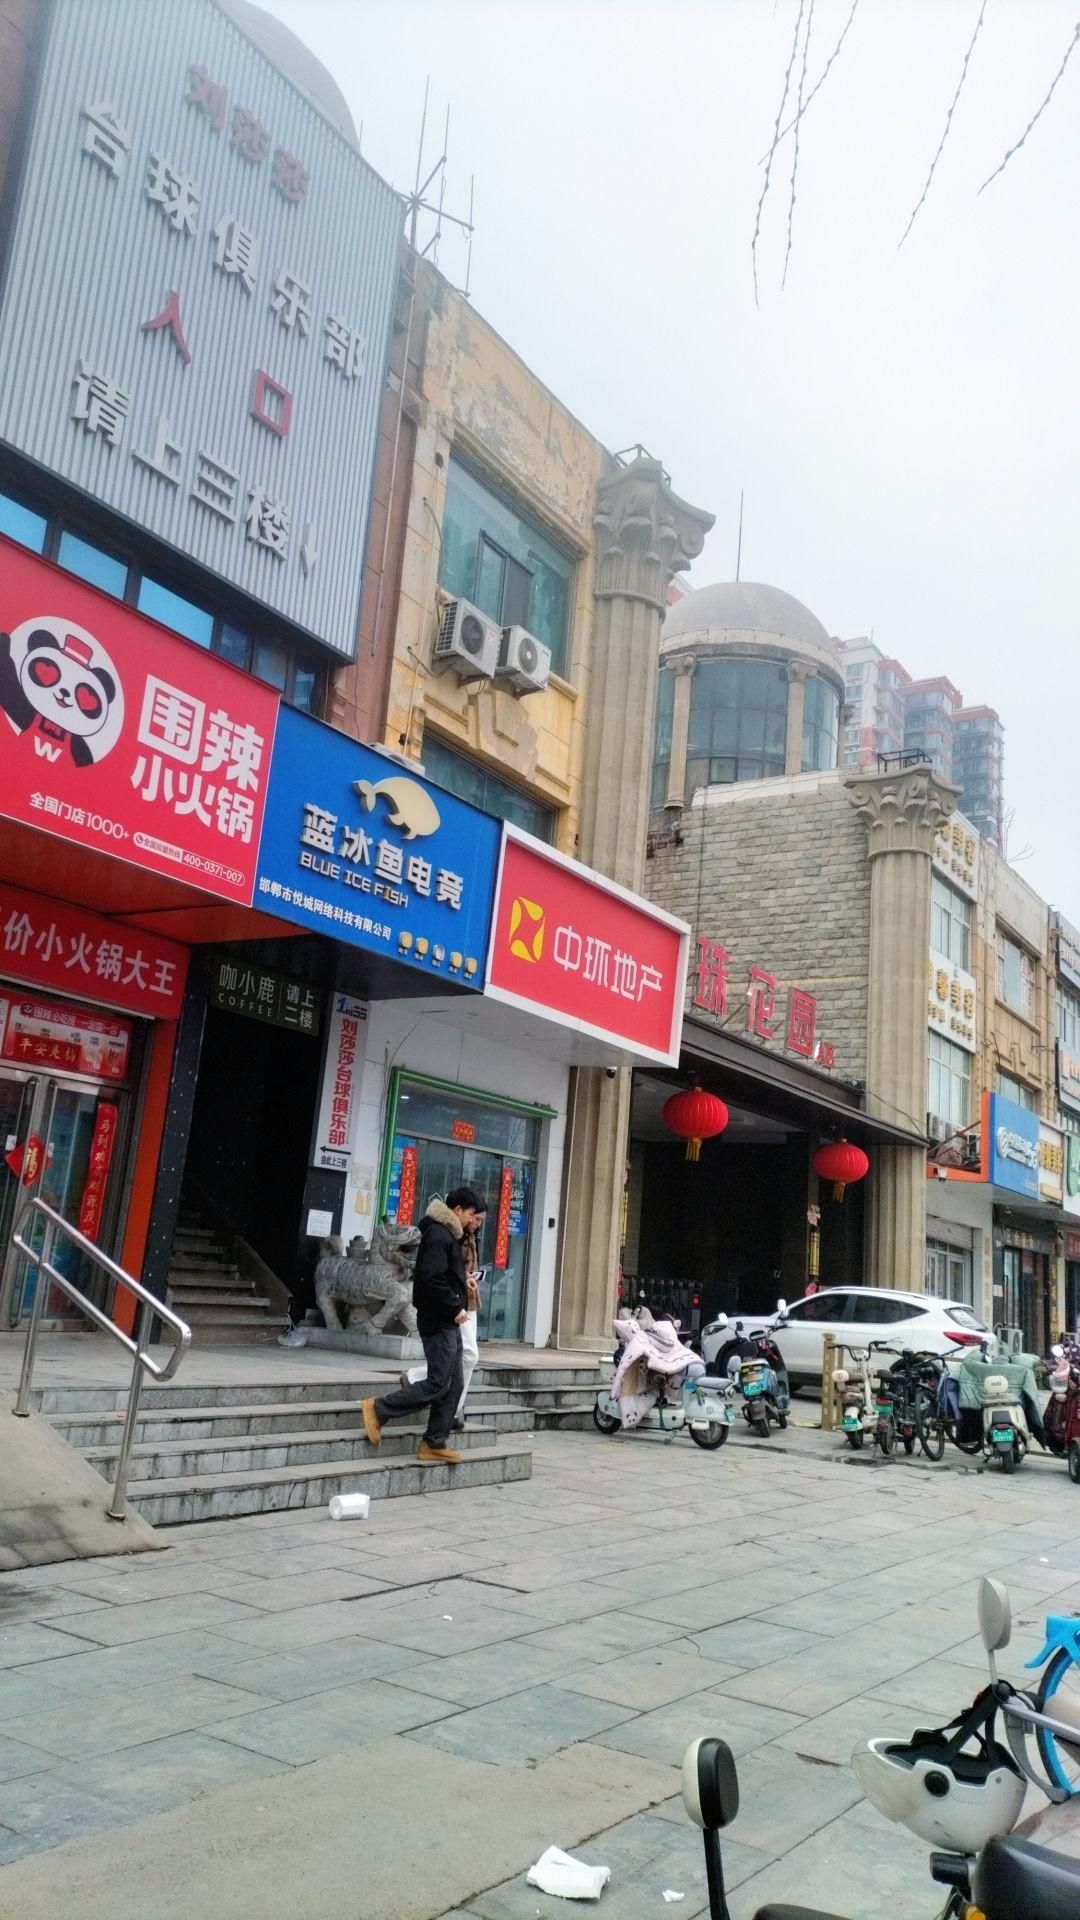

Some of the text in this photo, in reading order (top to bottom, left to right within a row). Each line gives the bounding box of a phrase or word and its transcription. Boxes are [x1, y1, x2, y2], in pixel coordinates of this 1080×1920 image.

[81, 103, 368, 380] 台球俱乐部
[71, 360, 292, 562] 请上三楼
[138, 674, 264, 792] 围辣
[30, 792, 130, 840] 全国门店1000+
[131, 755, 255, 844] 小火锅
[183, 853, 243, 883] 400-0371-007
[300, 803, 464, 911] 蓝冰鱼电竞
[300, 851, 409, 909] BLUE ICE FISH
[259, 877, 391, 941] 邯郸市悦城网络科技有限公司
[0, 905, 177, 997] 价小火锅大王
[553, 925, 663, 1002] 中环地产
[218, 992, 273, 1018] COFFEE
[219, 963, 276, 1004] 咖小鹿
[286, 984, 315, 1009] 请上
[284, 1006, 313, 1030] 二楼
[328, 1018, 359, 1147] 刘莎莎台球俱乐部
[320, 1155, 348, 1169] 由此上三楼
